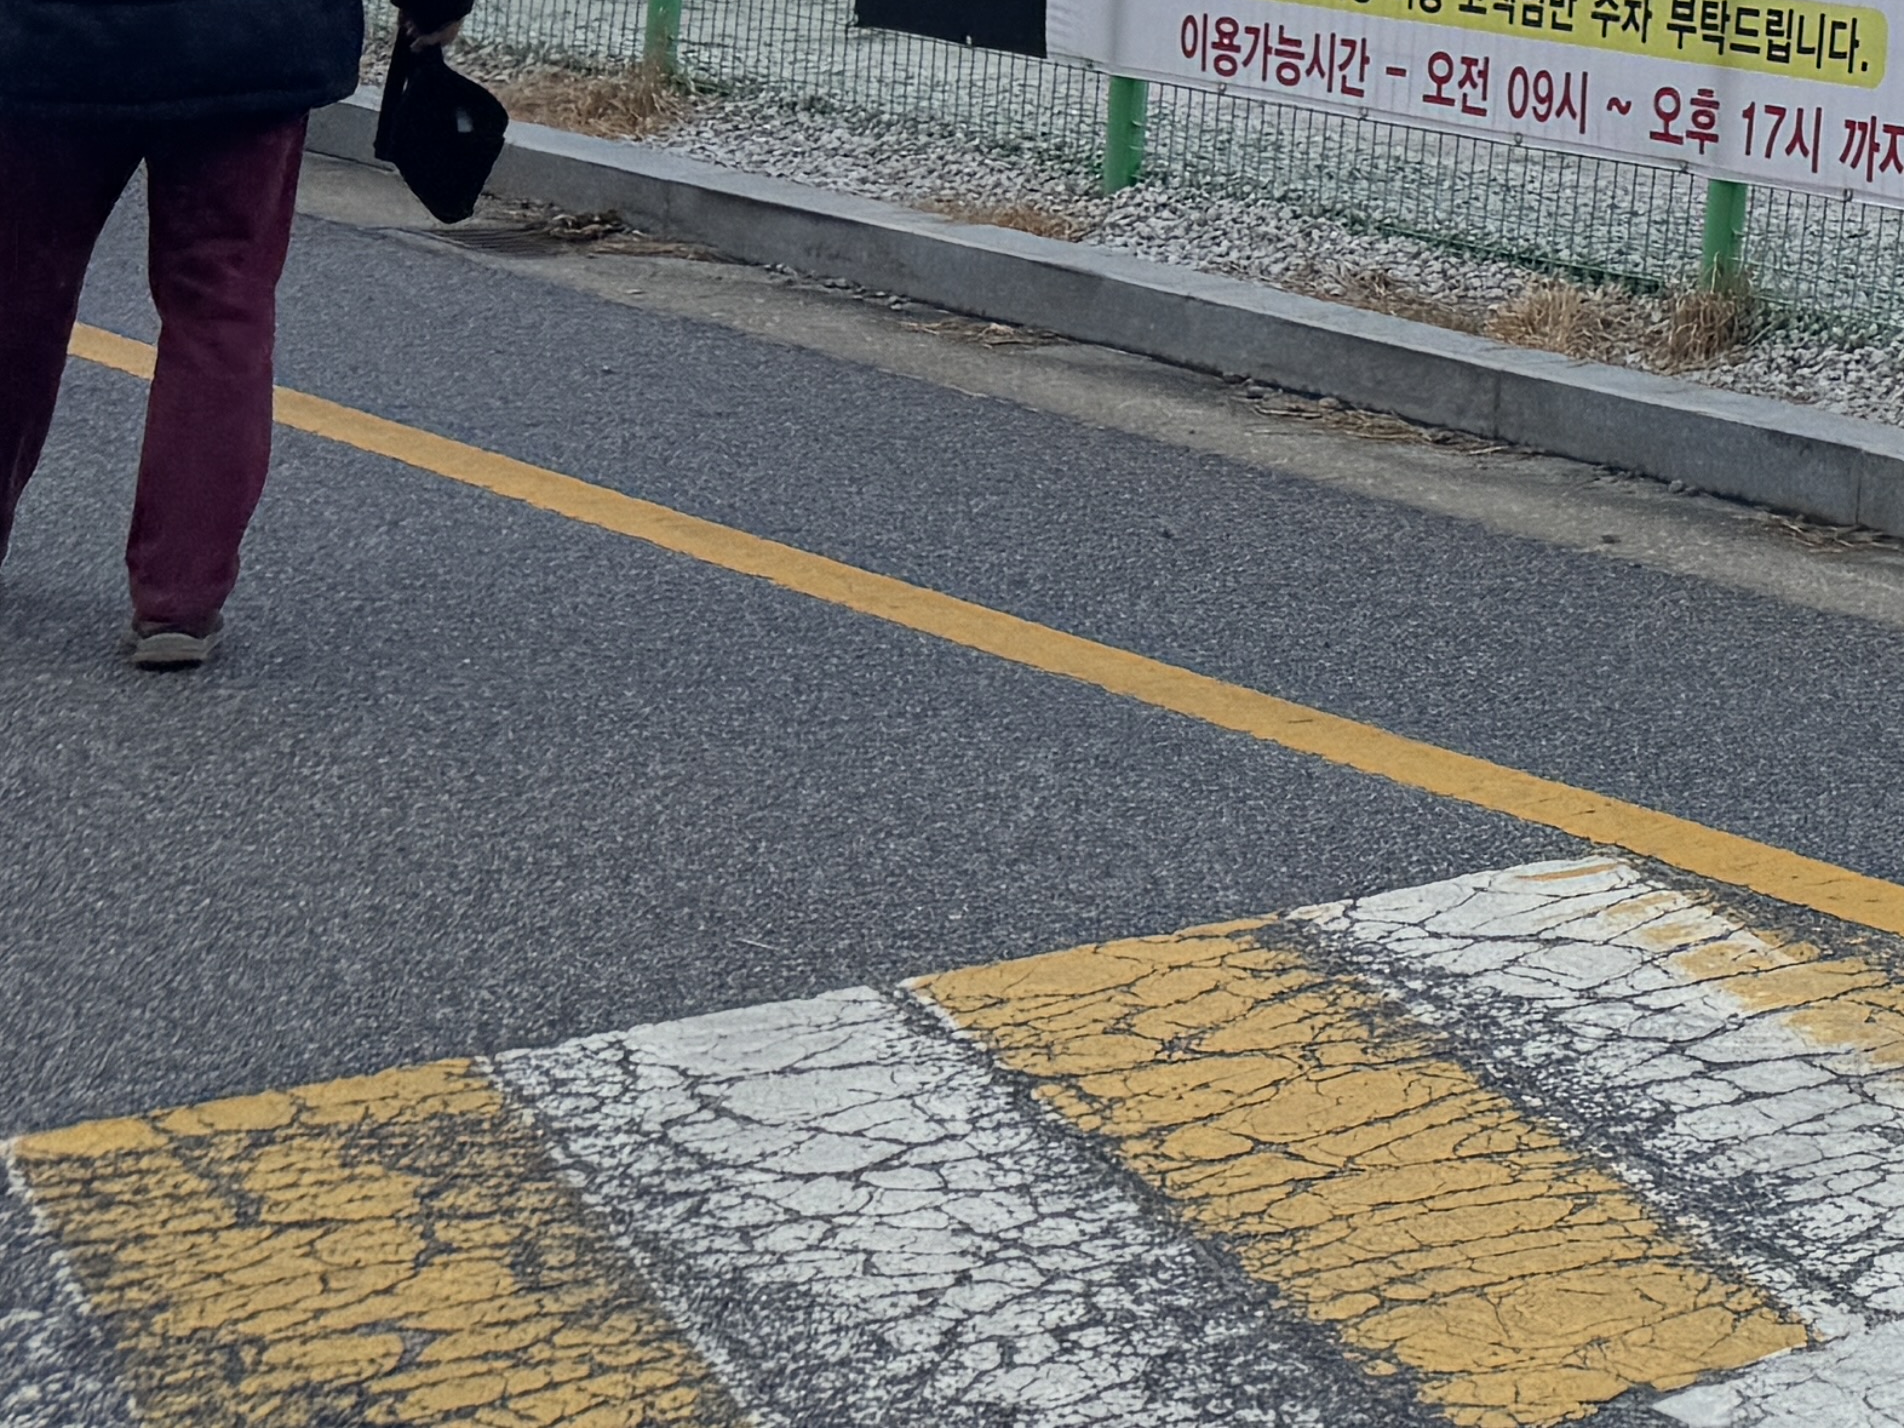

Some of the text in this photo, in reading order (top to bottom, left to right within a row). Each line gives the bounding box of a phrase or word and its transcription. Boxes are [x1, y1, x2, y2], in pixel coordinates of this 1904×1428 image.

[1180, 12, 1370, 98] 이용가능시간
[1422, 50, 1490, 118] 오전
[1507, 65, 1588, 135] 09시
[1649, 85, 1720, 156] 오후
[1741, 100, 1823, 174] 17시
